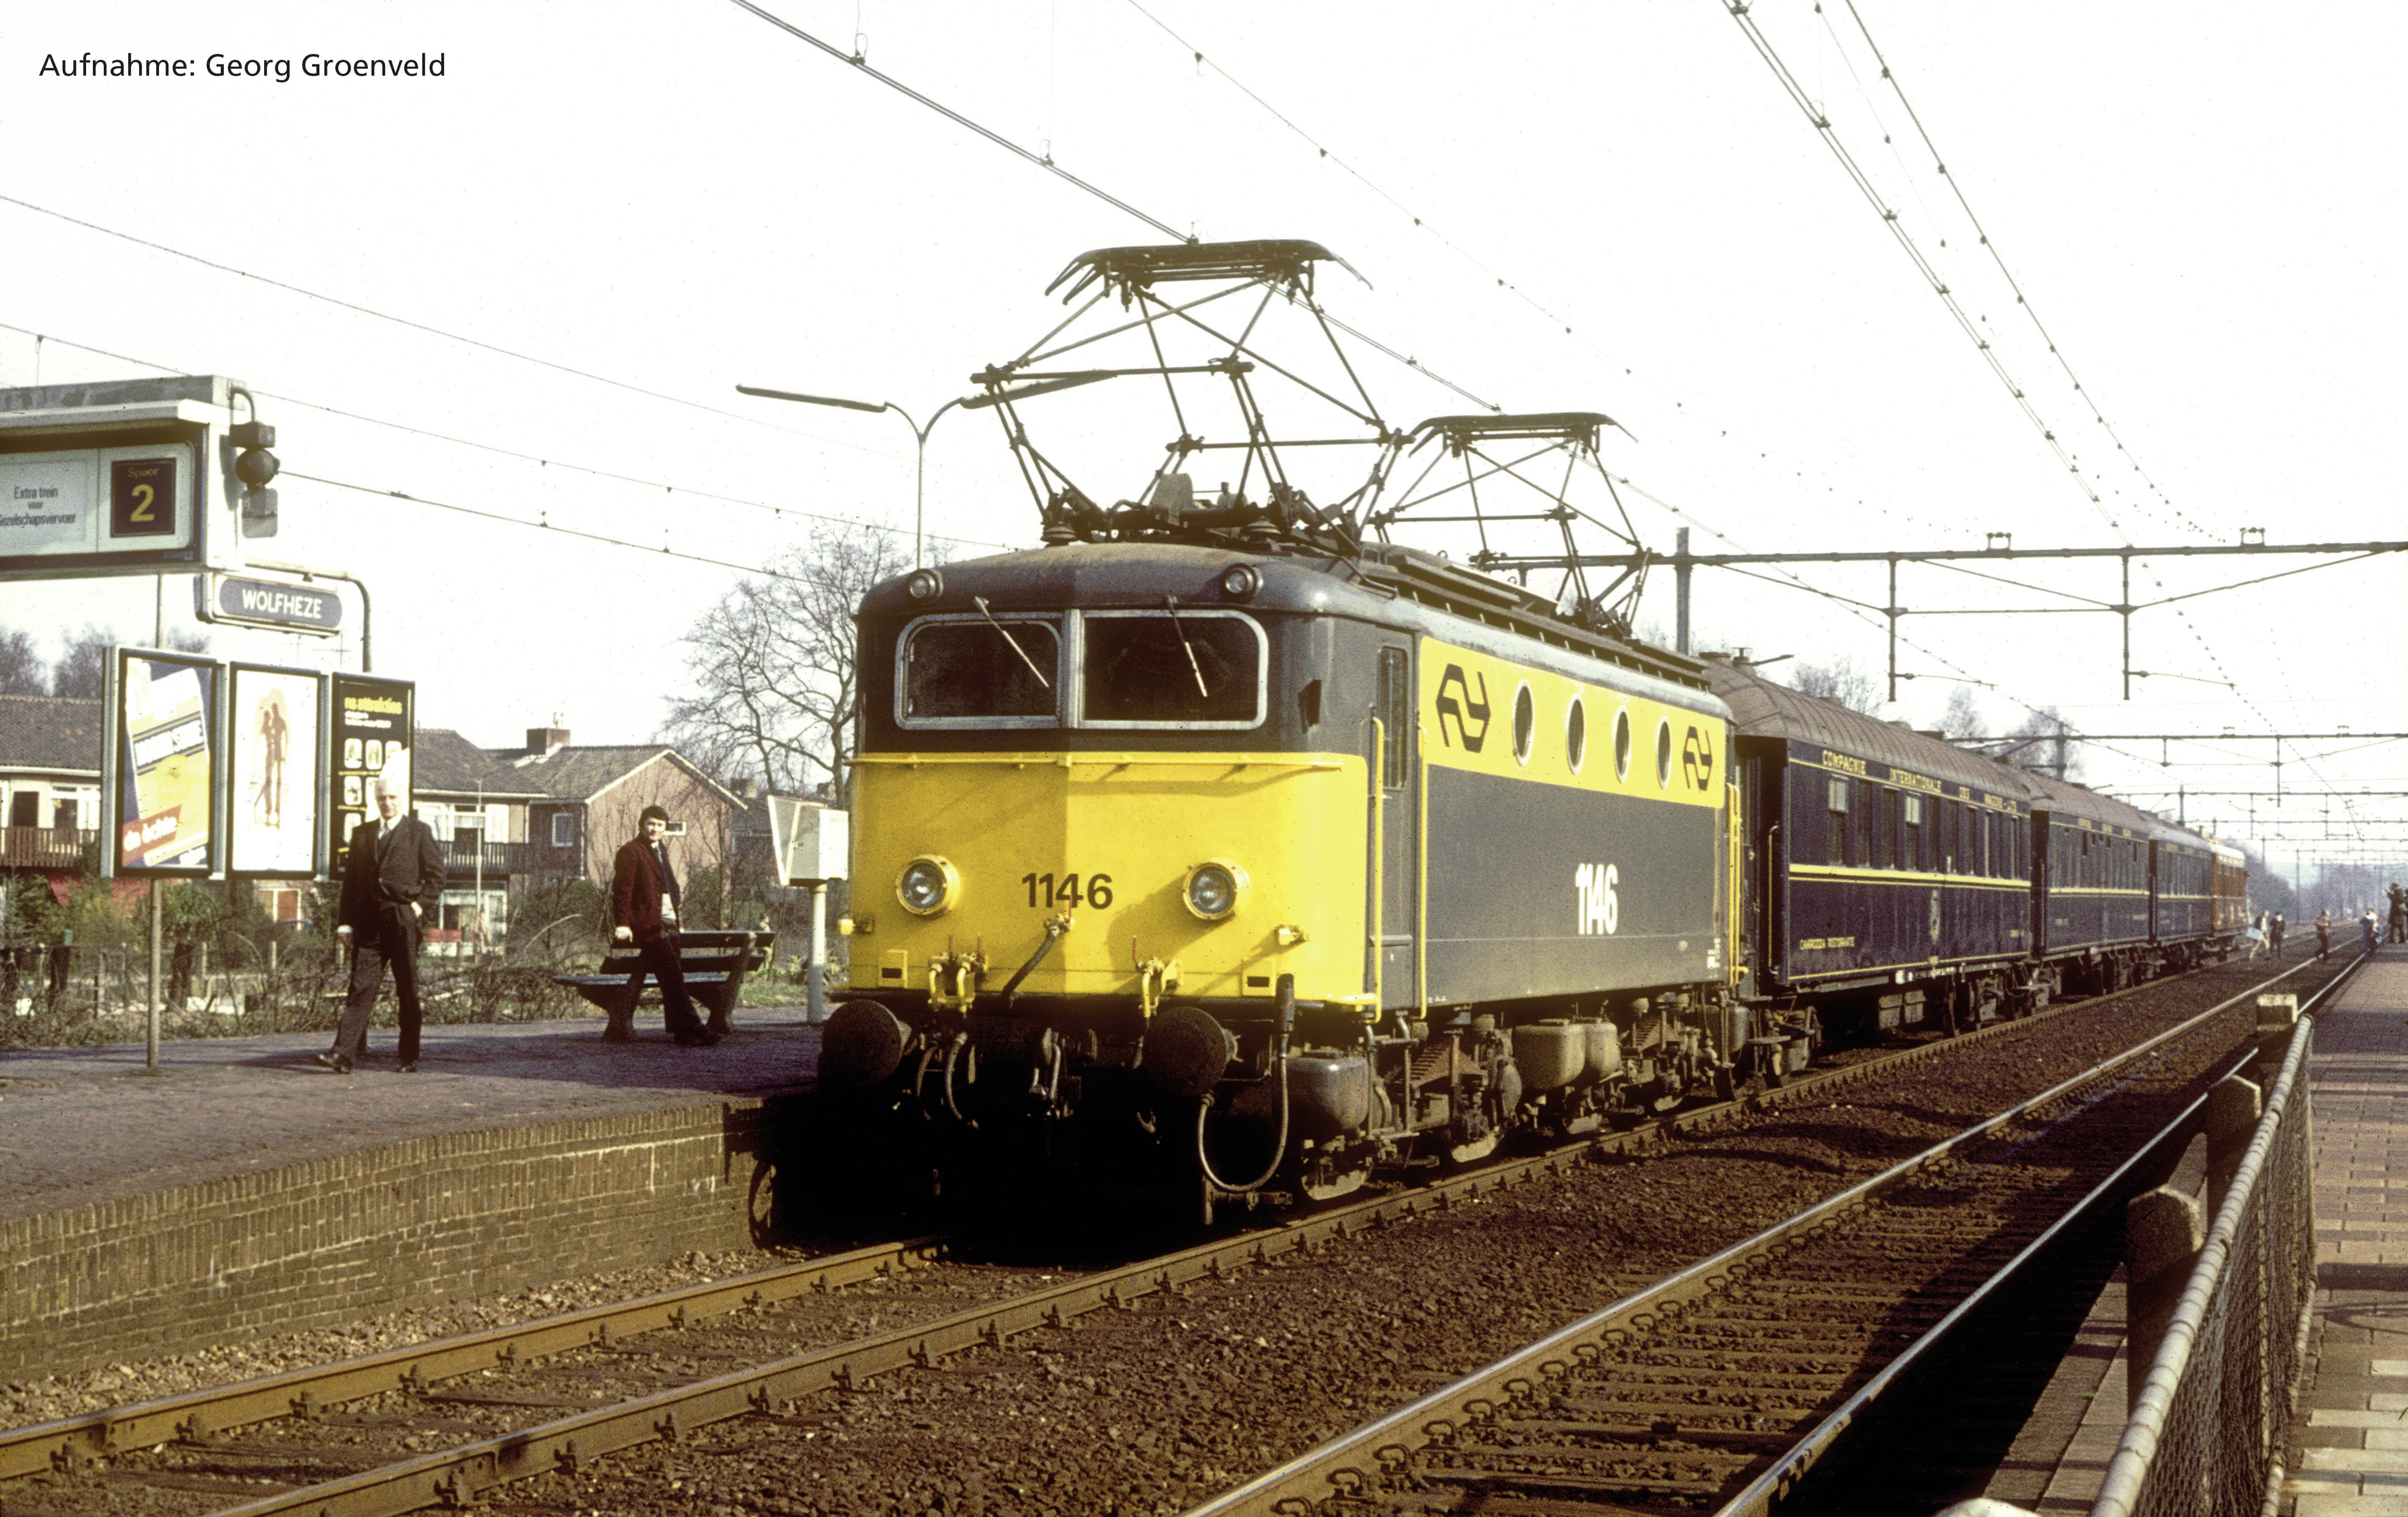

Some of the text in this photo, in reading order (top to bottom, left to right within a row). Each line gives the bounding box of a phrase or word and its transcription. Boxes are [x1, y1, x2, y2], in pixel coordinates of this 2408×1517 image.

[14, 485, 58, 499] Extra trein
[130, 483, 154, 522] 2
[242, 589, 322, 619] WOLFHEZE
[1022, 873, 1113, 909] 1146
[1575, 863, 1618, 935] 1146
